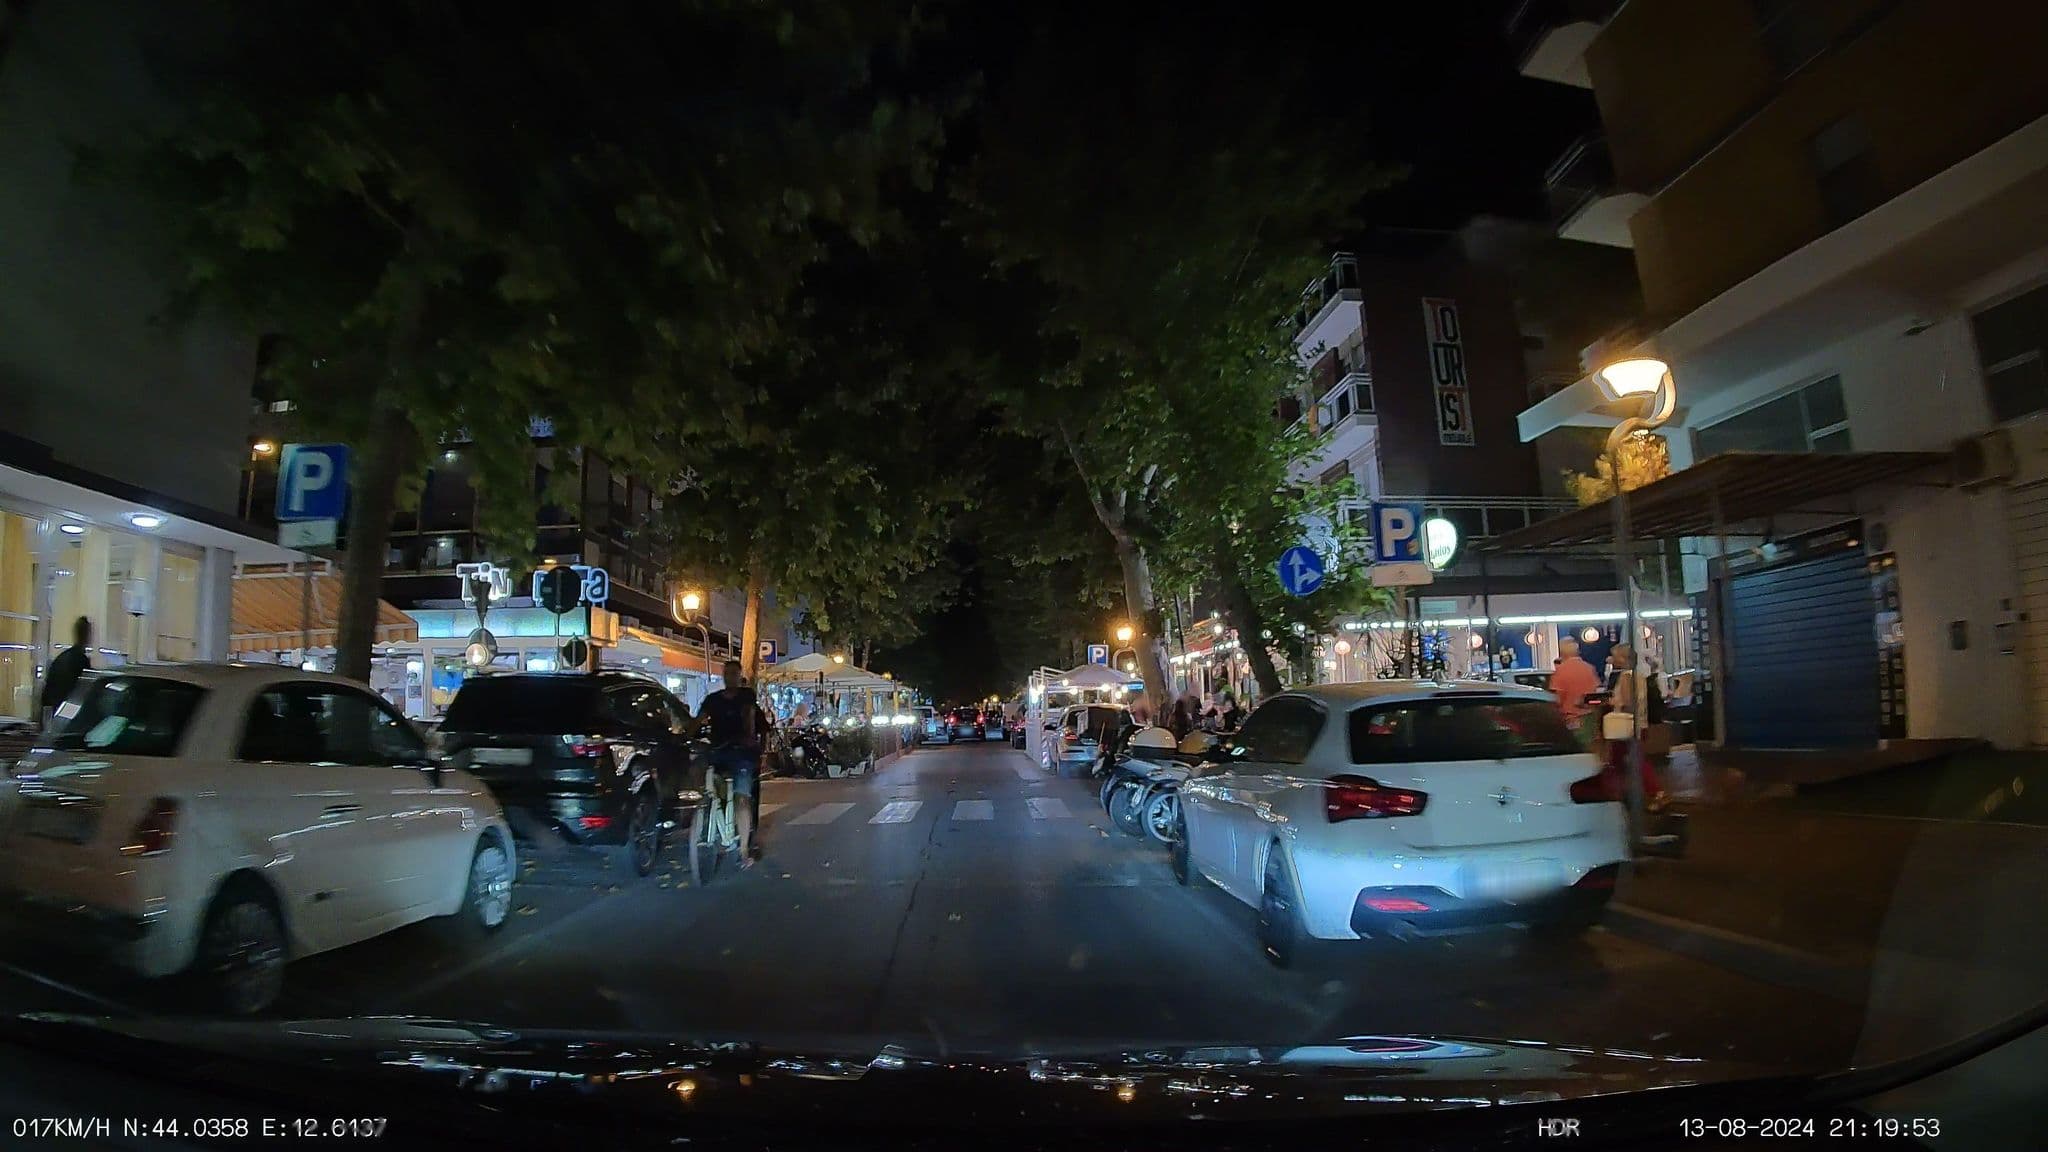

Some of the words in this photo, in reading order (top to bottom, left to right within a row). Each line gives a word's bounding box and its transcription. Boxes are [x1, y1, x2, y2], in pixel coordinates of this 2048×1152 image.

[288, 452, 333, 512] P
[1381, 508, 1415, 557] P
[759, 641, 773, 660] P
[1092, 648, 1105, 664] P
